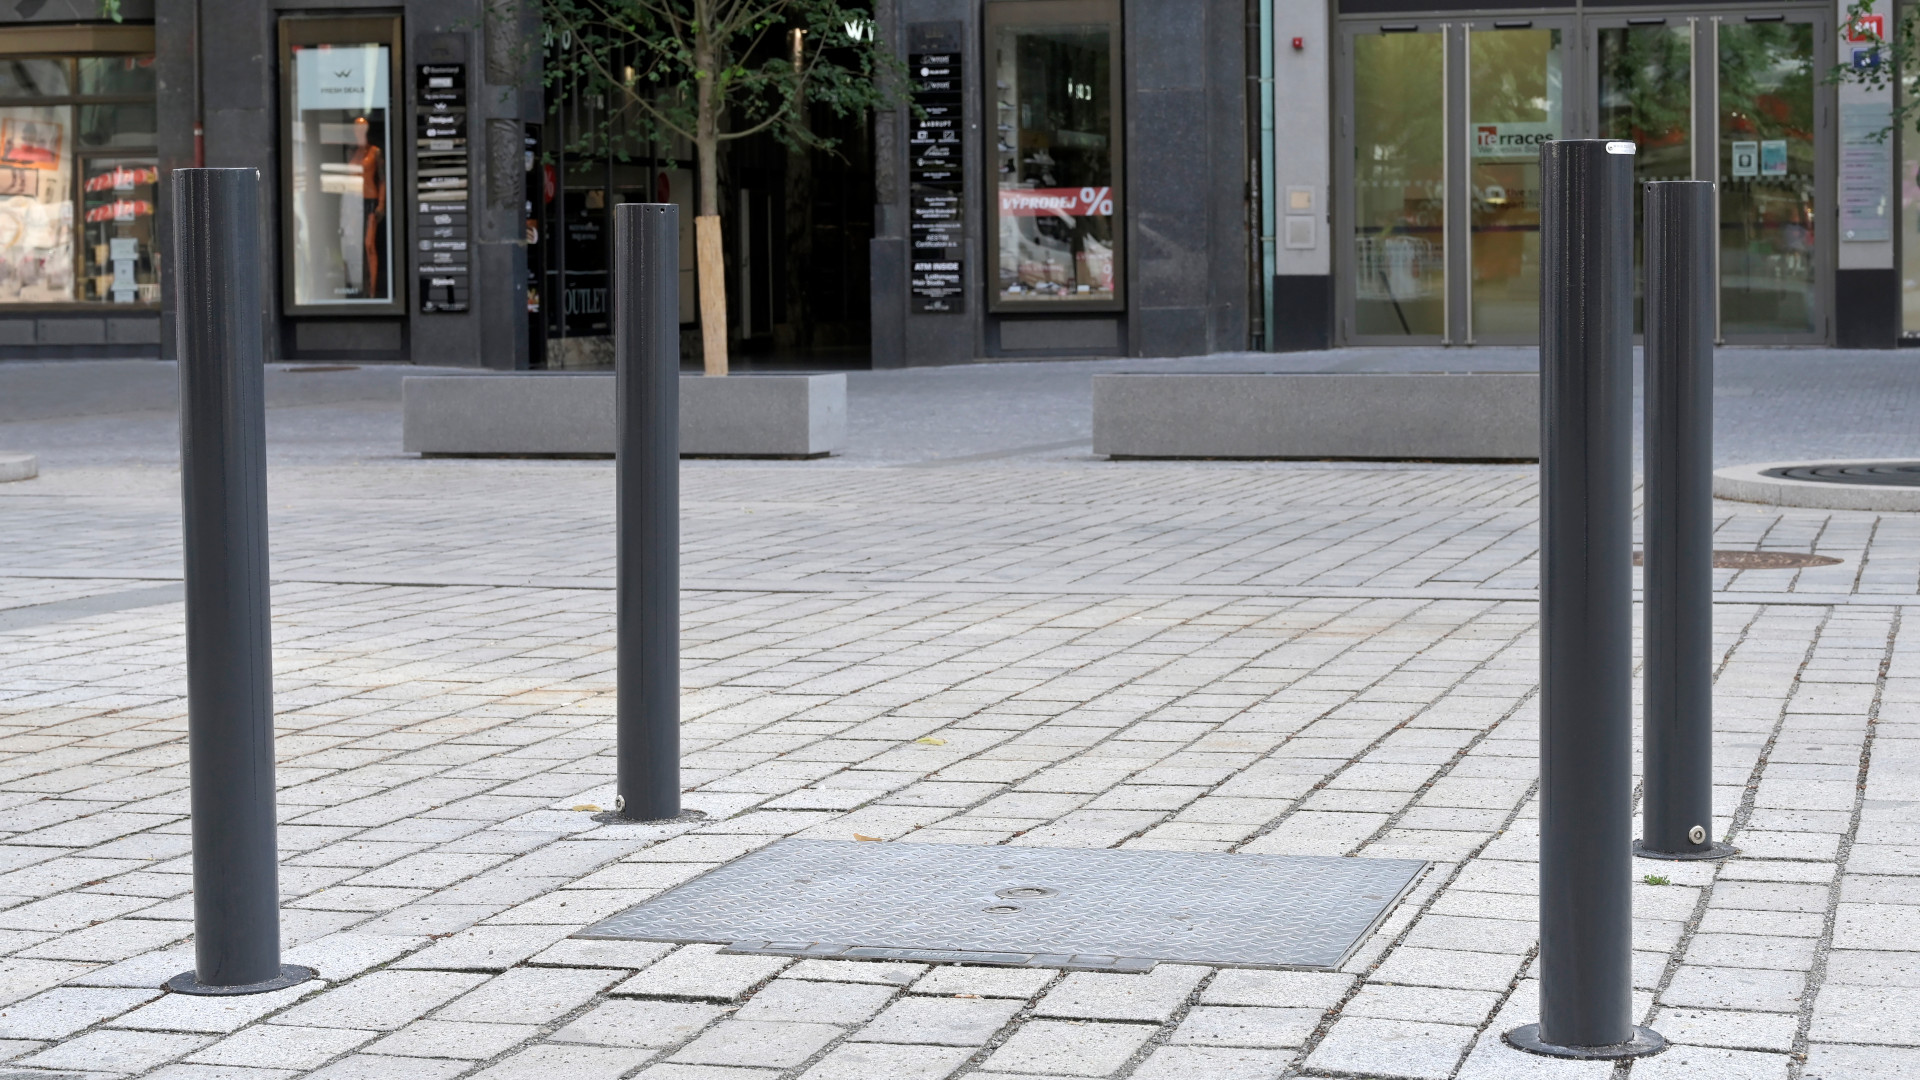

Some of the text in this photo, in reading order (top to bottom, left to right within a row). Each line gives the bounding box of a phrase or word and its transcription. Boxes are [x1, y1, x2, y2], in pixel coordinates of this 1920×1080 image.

[1478, 131, 1554, 146] Terraces
[1080, 186, 1113, 216] %
[914, 262, 959, 271] ATM INSIDE
[563, 287, 608, 316] OUTLET
